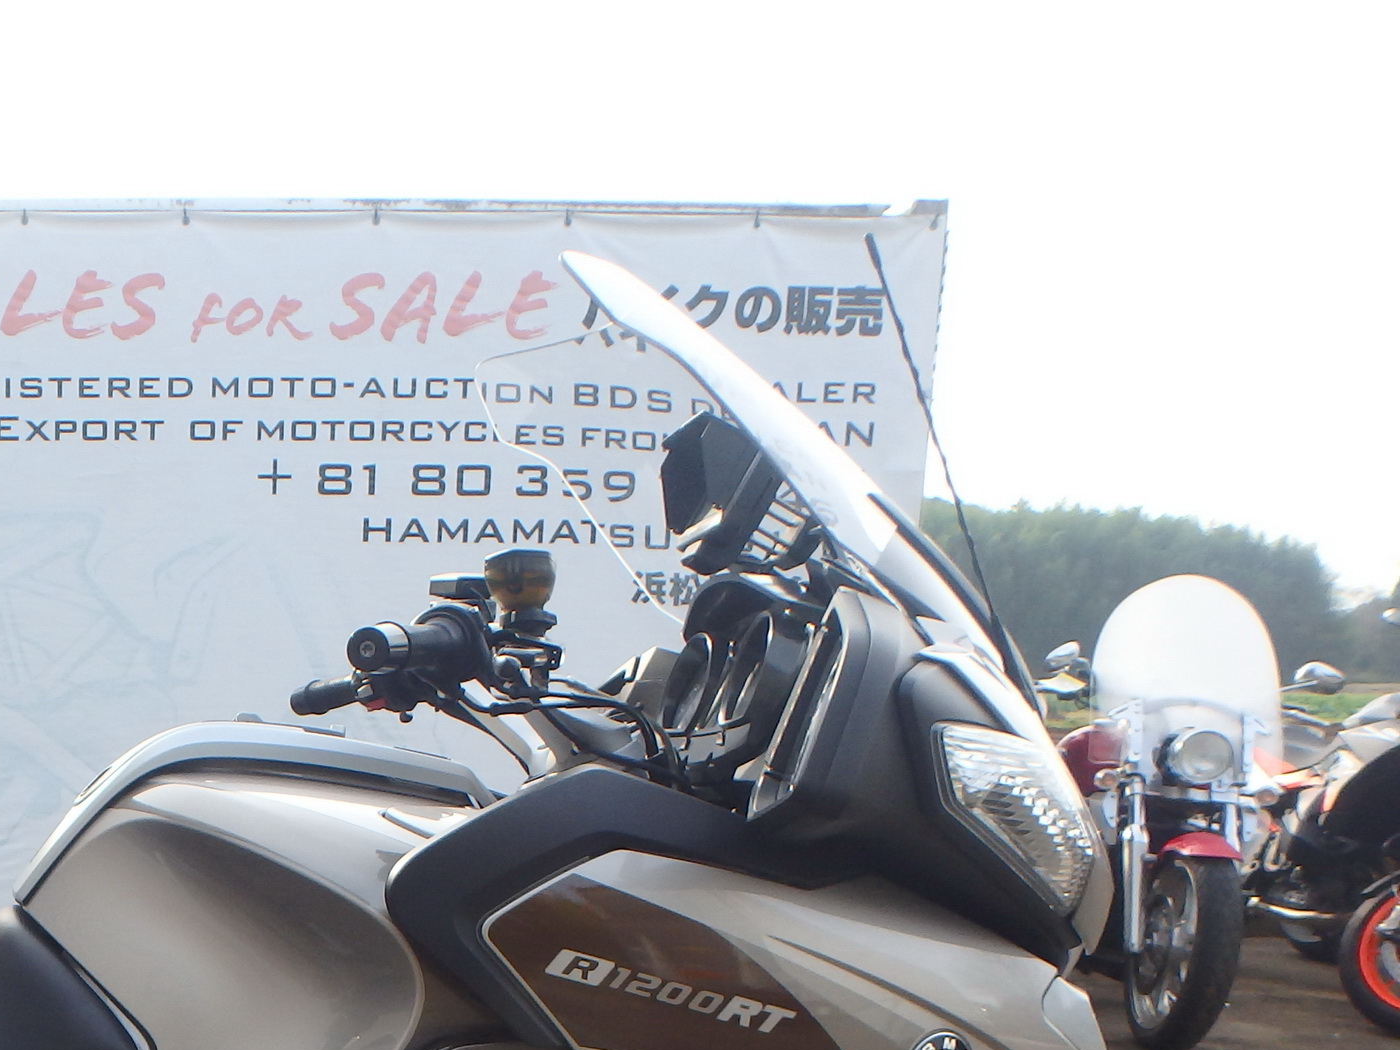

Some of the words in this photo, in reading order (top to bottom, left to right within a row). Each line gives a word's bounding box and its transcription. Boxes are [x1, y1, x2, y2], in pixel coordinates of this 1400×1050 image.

[329, 270, 559, 344] SALE
[211, 377, 553, 405] MOTO-AUCTION
[573, 382, 673, 413] BDS
[190, 420, 244, 441] OF
[257, 420, 565, 446] MOTORCYCLES
[318, 463, 377, 496] 81
[411, 463, 492, 496] 80
[516, 464, 637, 502] 359
[362, 518, 671, 550] HAMAMATSU
[545, 948, 797, 1034] R1200RT
